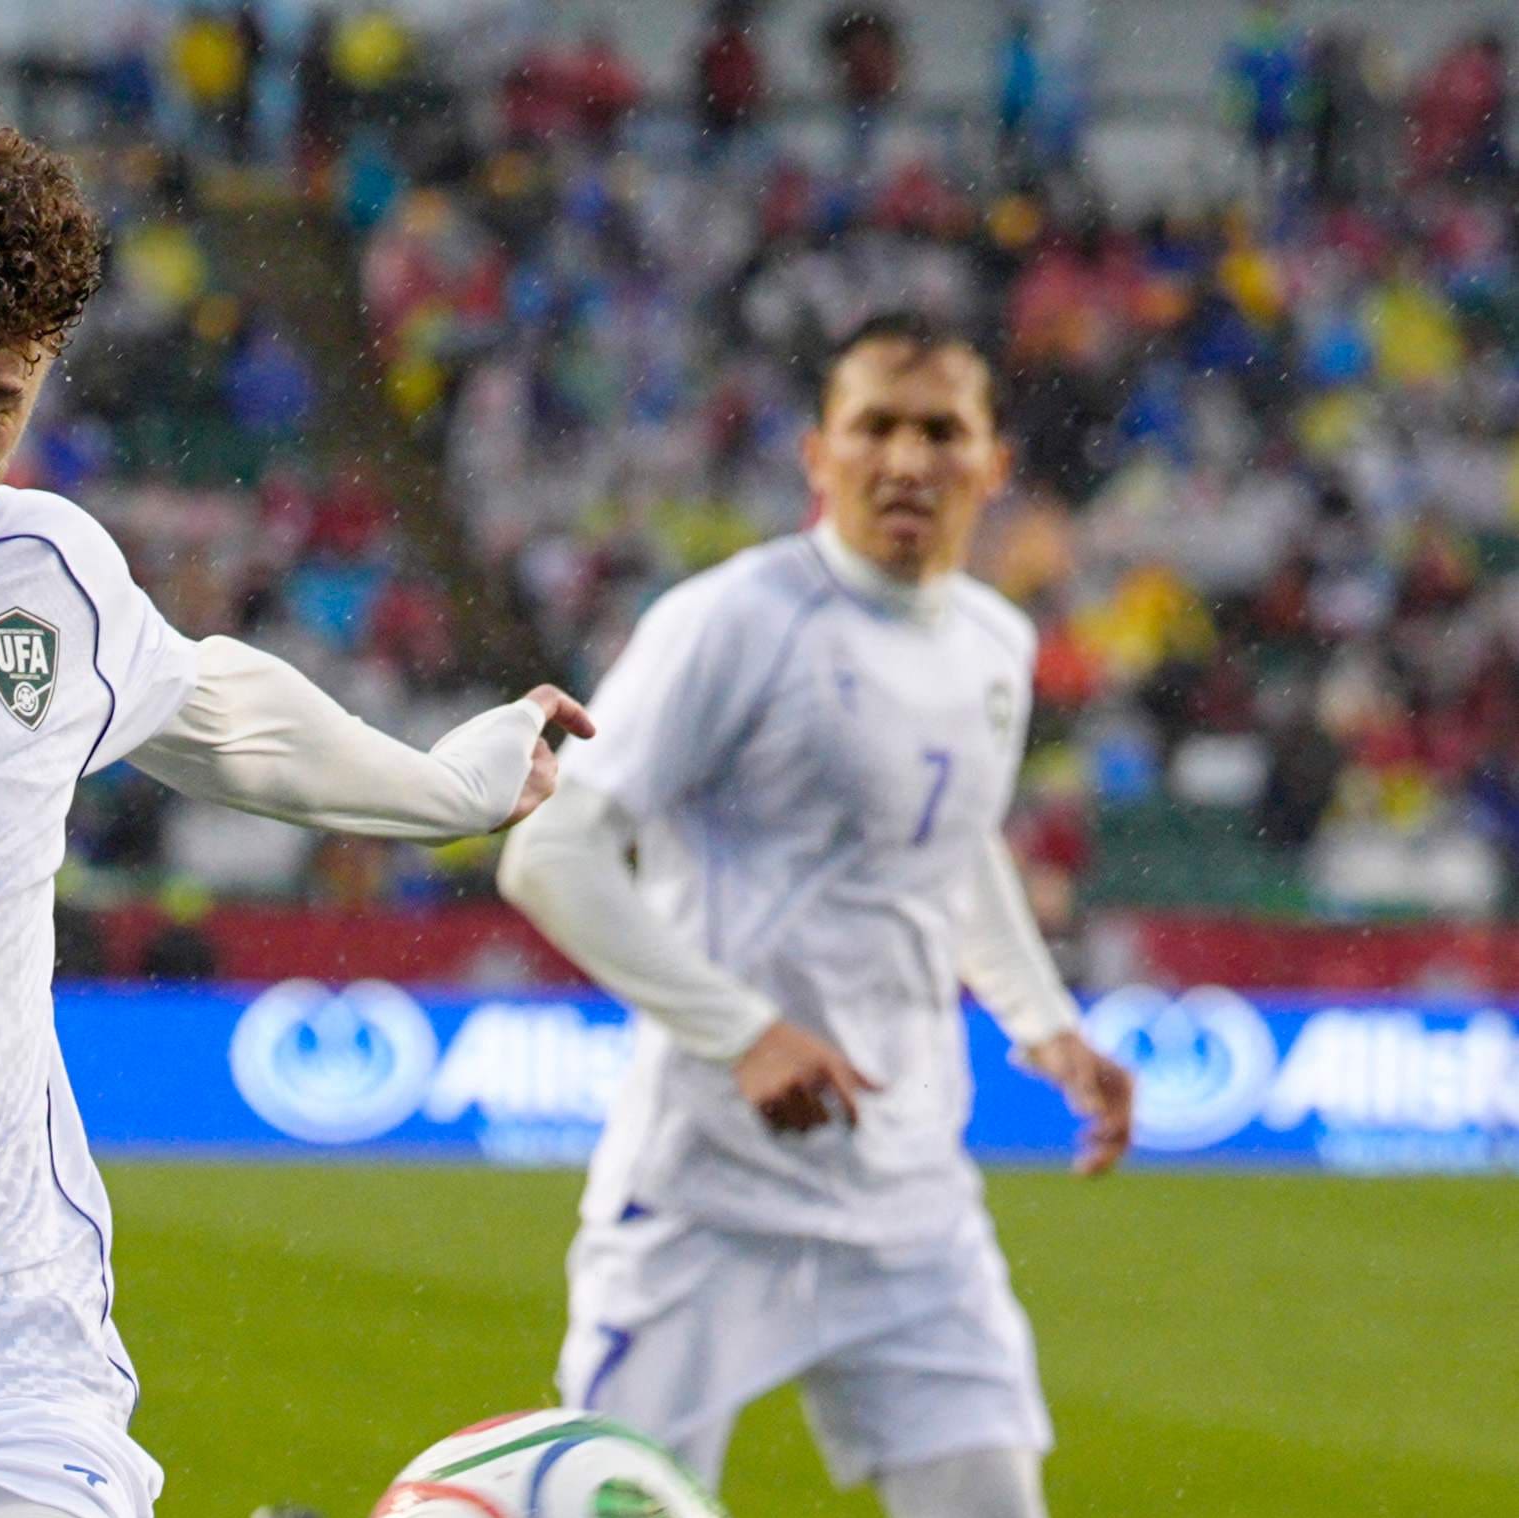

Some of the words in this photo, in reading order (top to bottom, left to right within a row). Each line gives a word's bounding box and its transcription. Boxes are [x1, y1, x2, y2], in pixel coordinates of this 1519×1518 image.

[912, 748, 951, 846] 7
[429, 1004, 619, 1121] Alls
[1267, 1011, 1519, 1128] Allst
